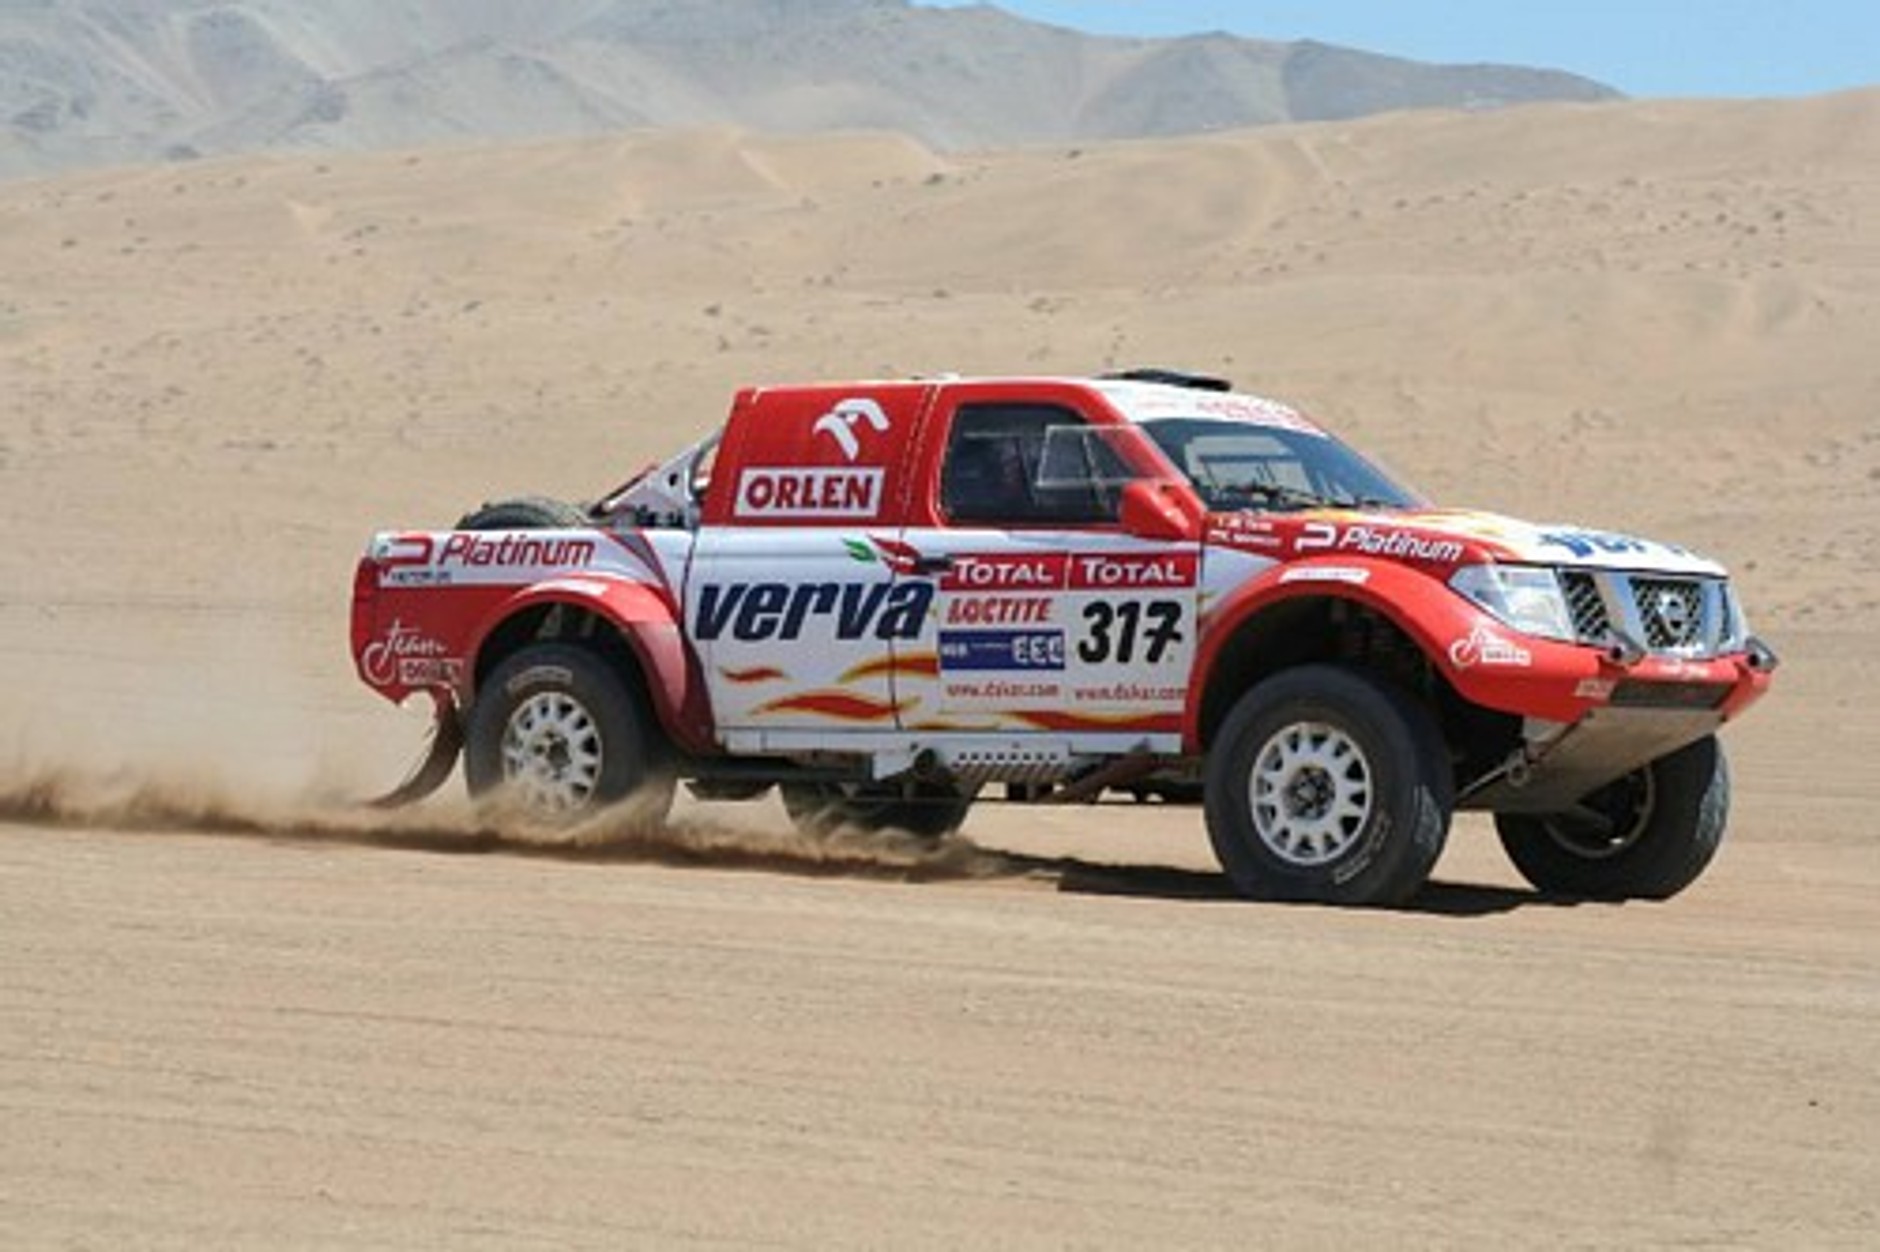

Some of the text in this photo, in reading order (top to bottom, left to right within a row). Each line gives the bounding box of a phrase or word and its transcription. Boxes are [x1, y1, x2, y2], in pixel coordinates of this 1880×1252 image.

[745, 474, 874, 509] ORLEN
[436, 534, 596, 567] Platinum
[1338, 524, 1464, 562] Platinum
[954, 557, 1055, 584] TOTAL
[1080, 557, 1186, 584] TOTAL
[694, 581, 935, 641] verva
[947, 597, 1054, 623] LOCTITE
[1077, 600, 1183, 663] 317
